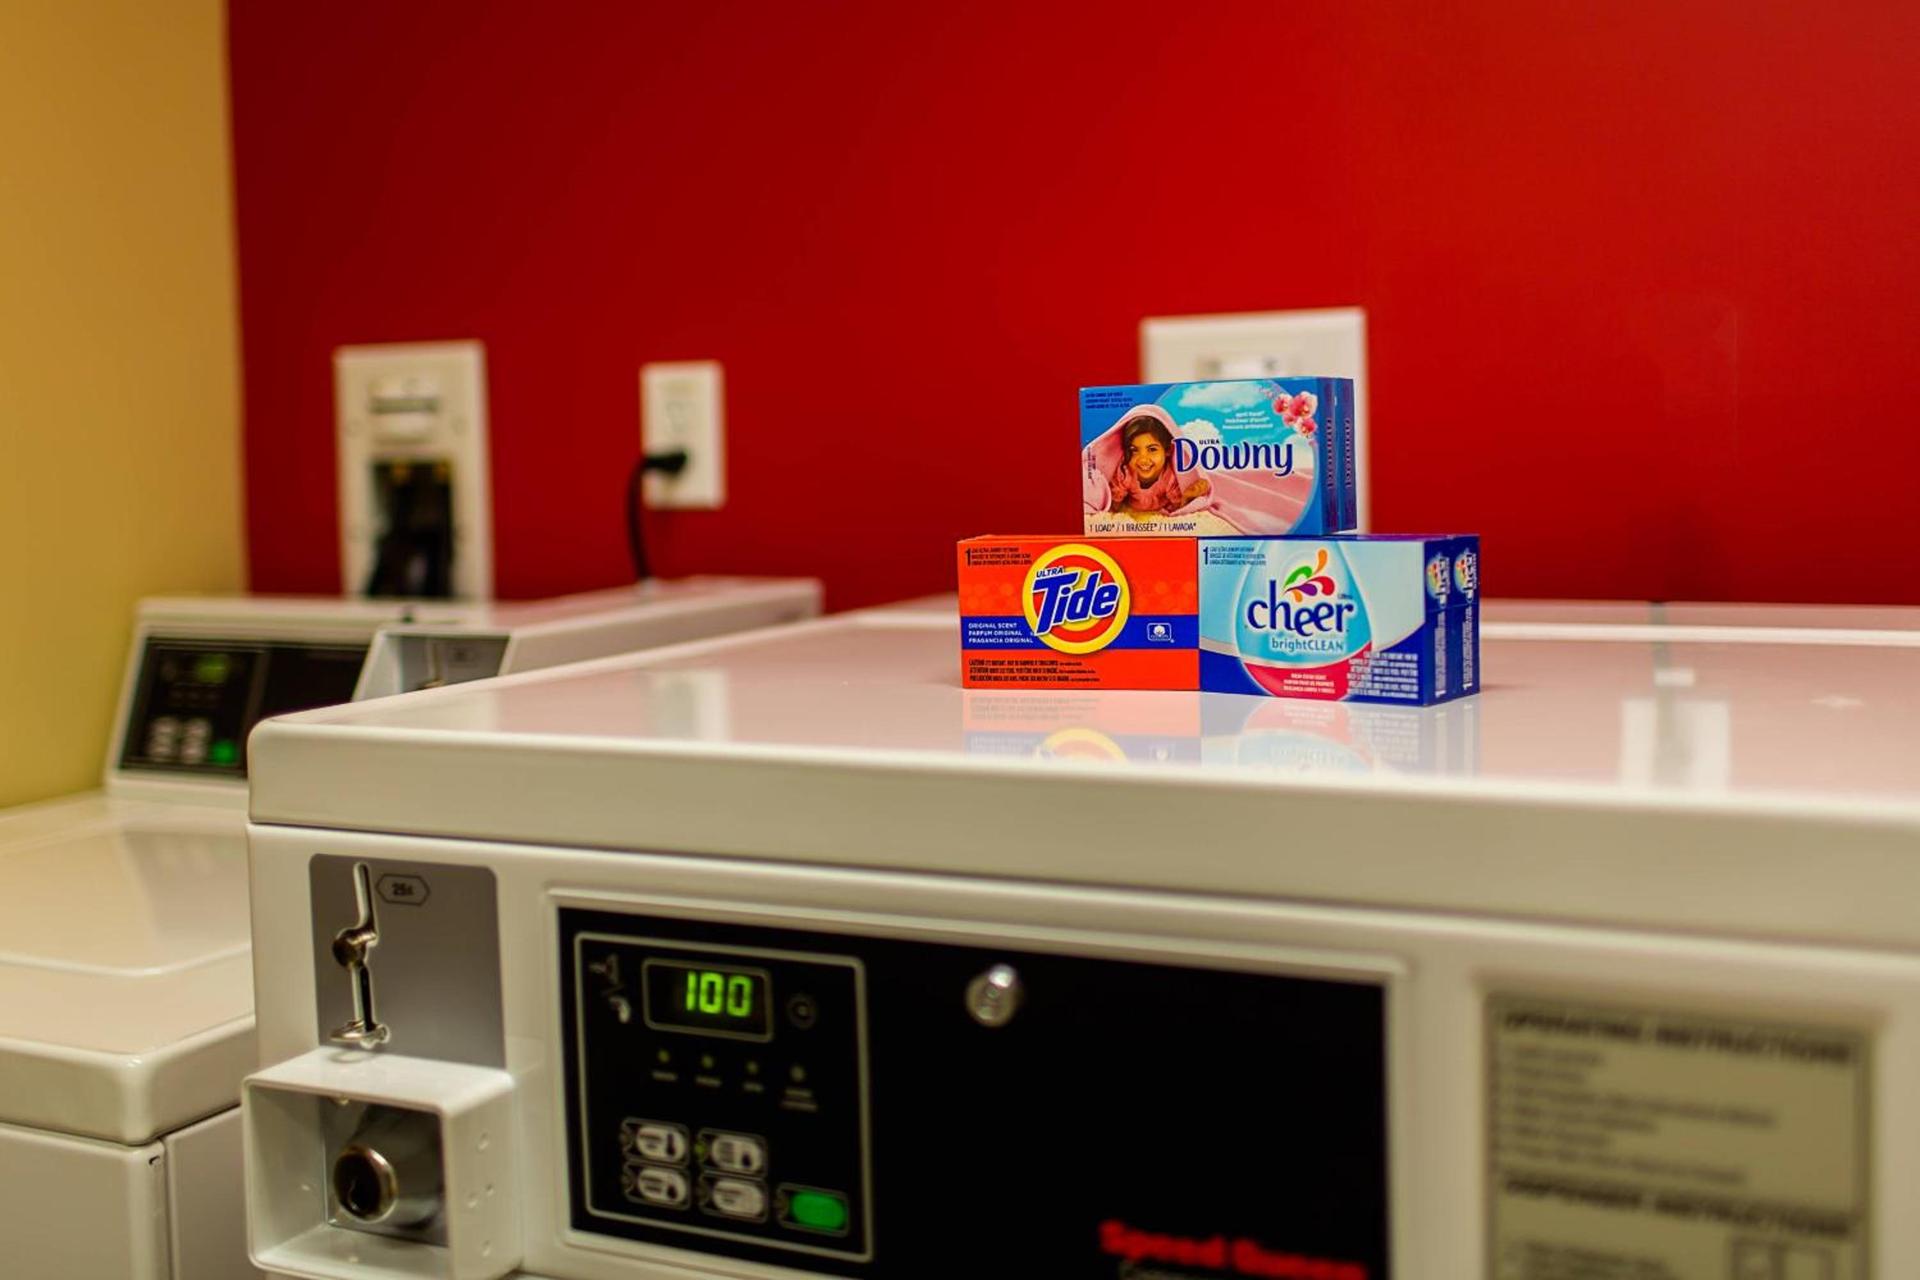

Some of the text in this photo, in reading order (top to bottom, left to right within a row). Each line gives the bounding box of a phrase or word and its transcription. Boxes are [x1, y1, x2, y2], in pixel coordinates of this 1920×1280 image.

[1173, 438, 1293, 477] Downy
[1037, 566, 1064, 578] ULTRA
[1203, 546, 1208, 565] 1
[1032, 570, 1119, 635] Tide
[1247, 579, 1354, 637] cheer
[1271, 637, 1344, 652] brightCLEAN
[685, 970, 753, 1018] 100
